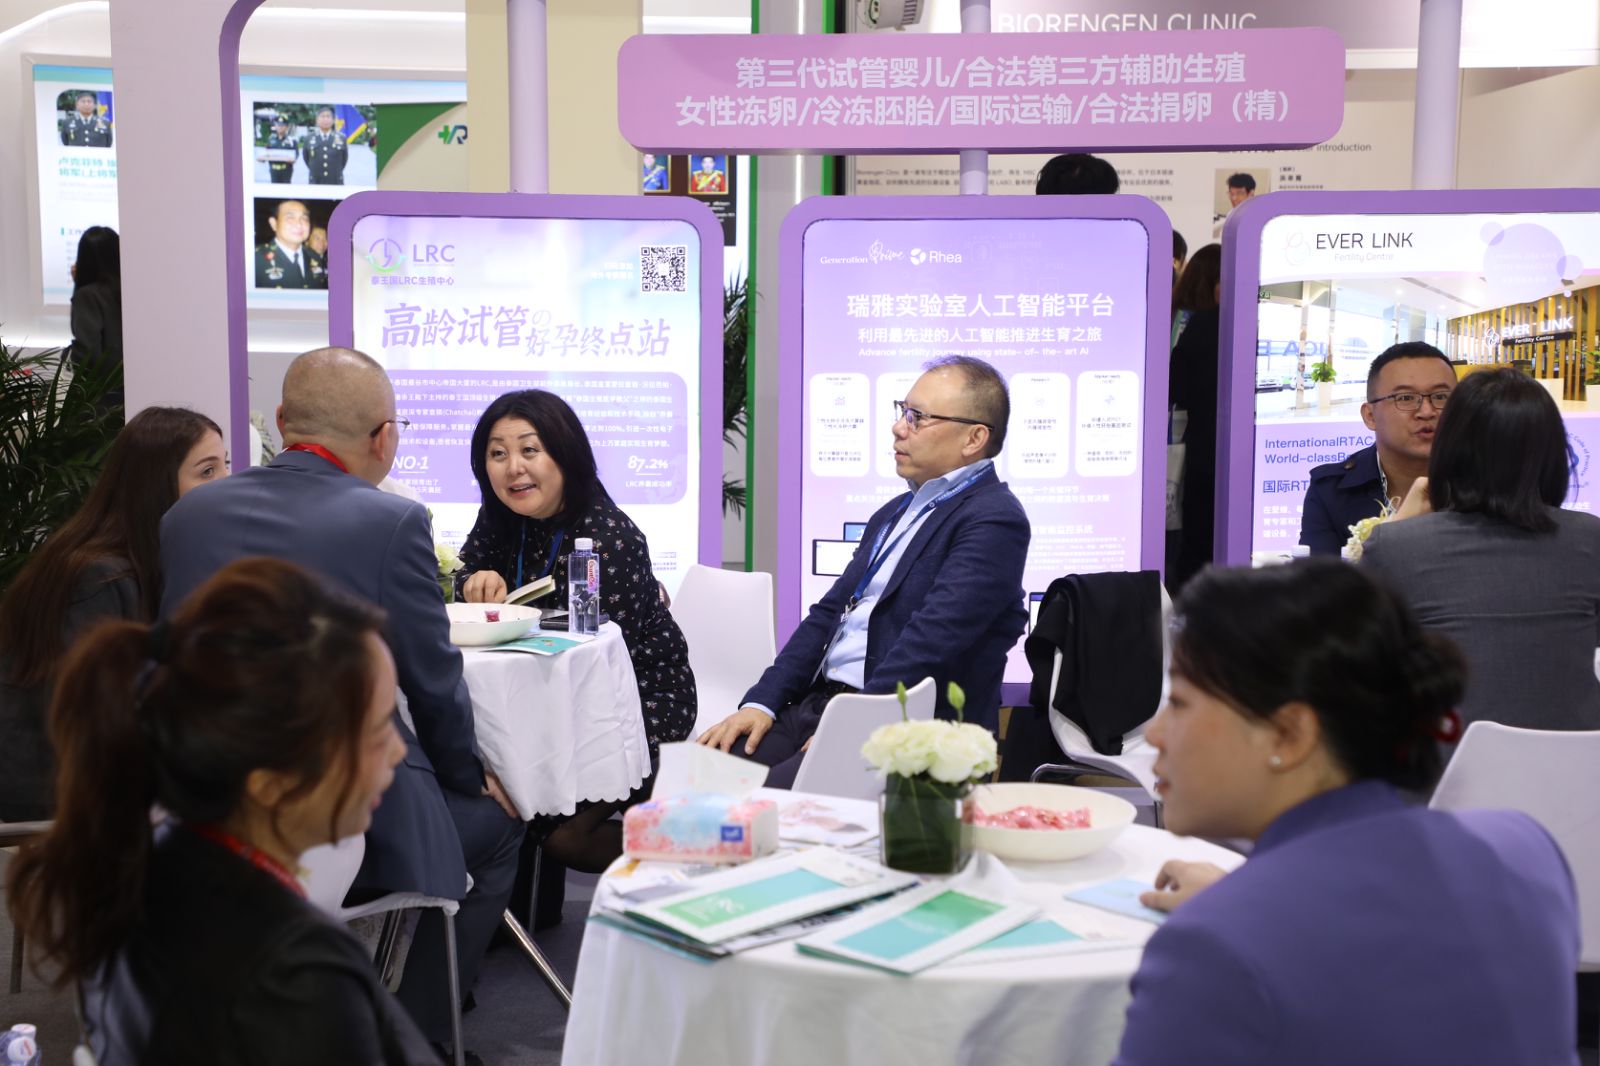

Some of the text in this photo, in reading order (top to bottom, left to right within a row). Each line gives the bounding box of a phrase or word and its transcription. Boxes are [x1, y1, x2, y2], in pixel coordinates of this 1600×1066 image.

[736, 52, 1247, 89] 第三代试管婴儿/合法第三方辅助生殖
[1316, 232, 1413, 249] EVER LINK
[412, 244, 456, 263] LRC
[820, 255, 868, 265] Generation
[929, 251, 962, 264] Rhea
[1334, 252, 1394, 264] Fertility Centre
[847, 293, 1114, 318] 瑞雅实验室人工智能平台
[1501, 316, 1574, 337] EVER LINK
[858, 327, 1103, 344] 利用最先进的人工智能推进生育之旅
[858, 348, 896, 357] Advance
[967, 348, 992, 358] using
[1064, 347, 1078, 356] art
[1079, 346, 1089, 355] AI
